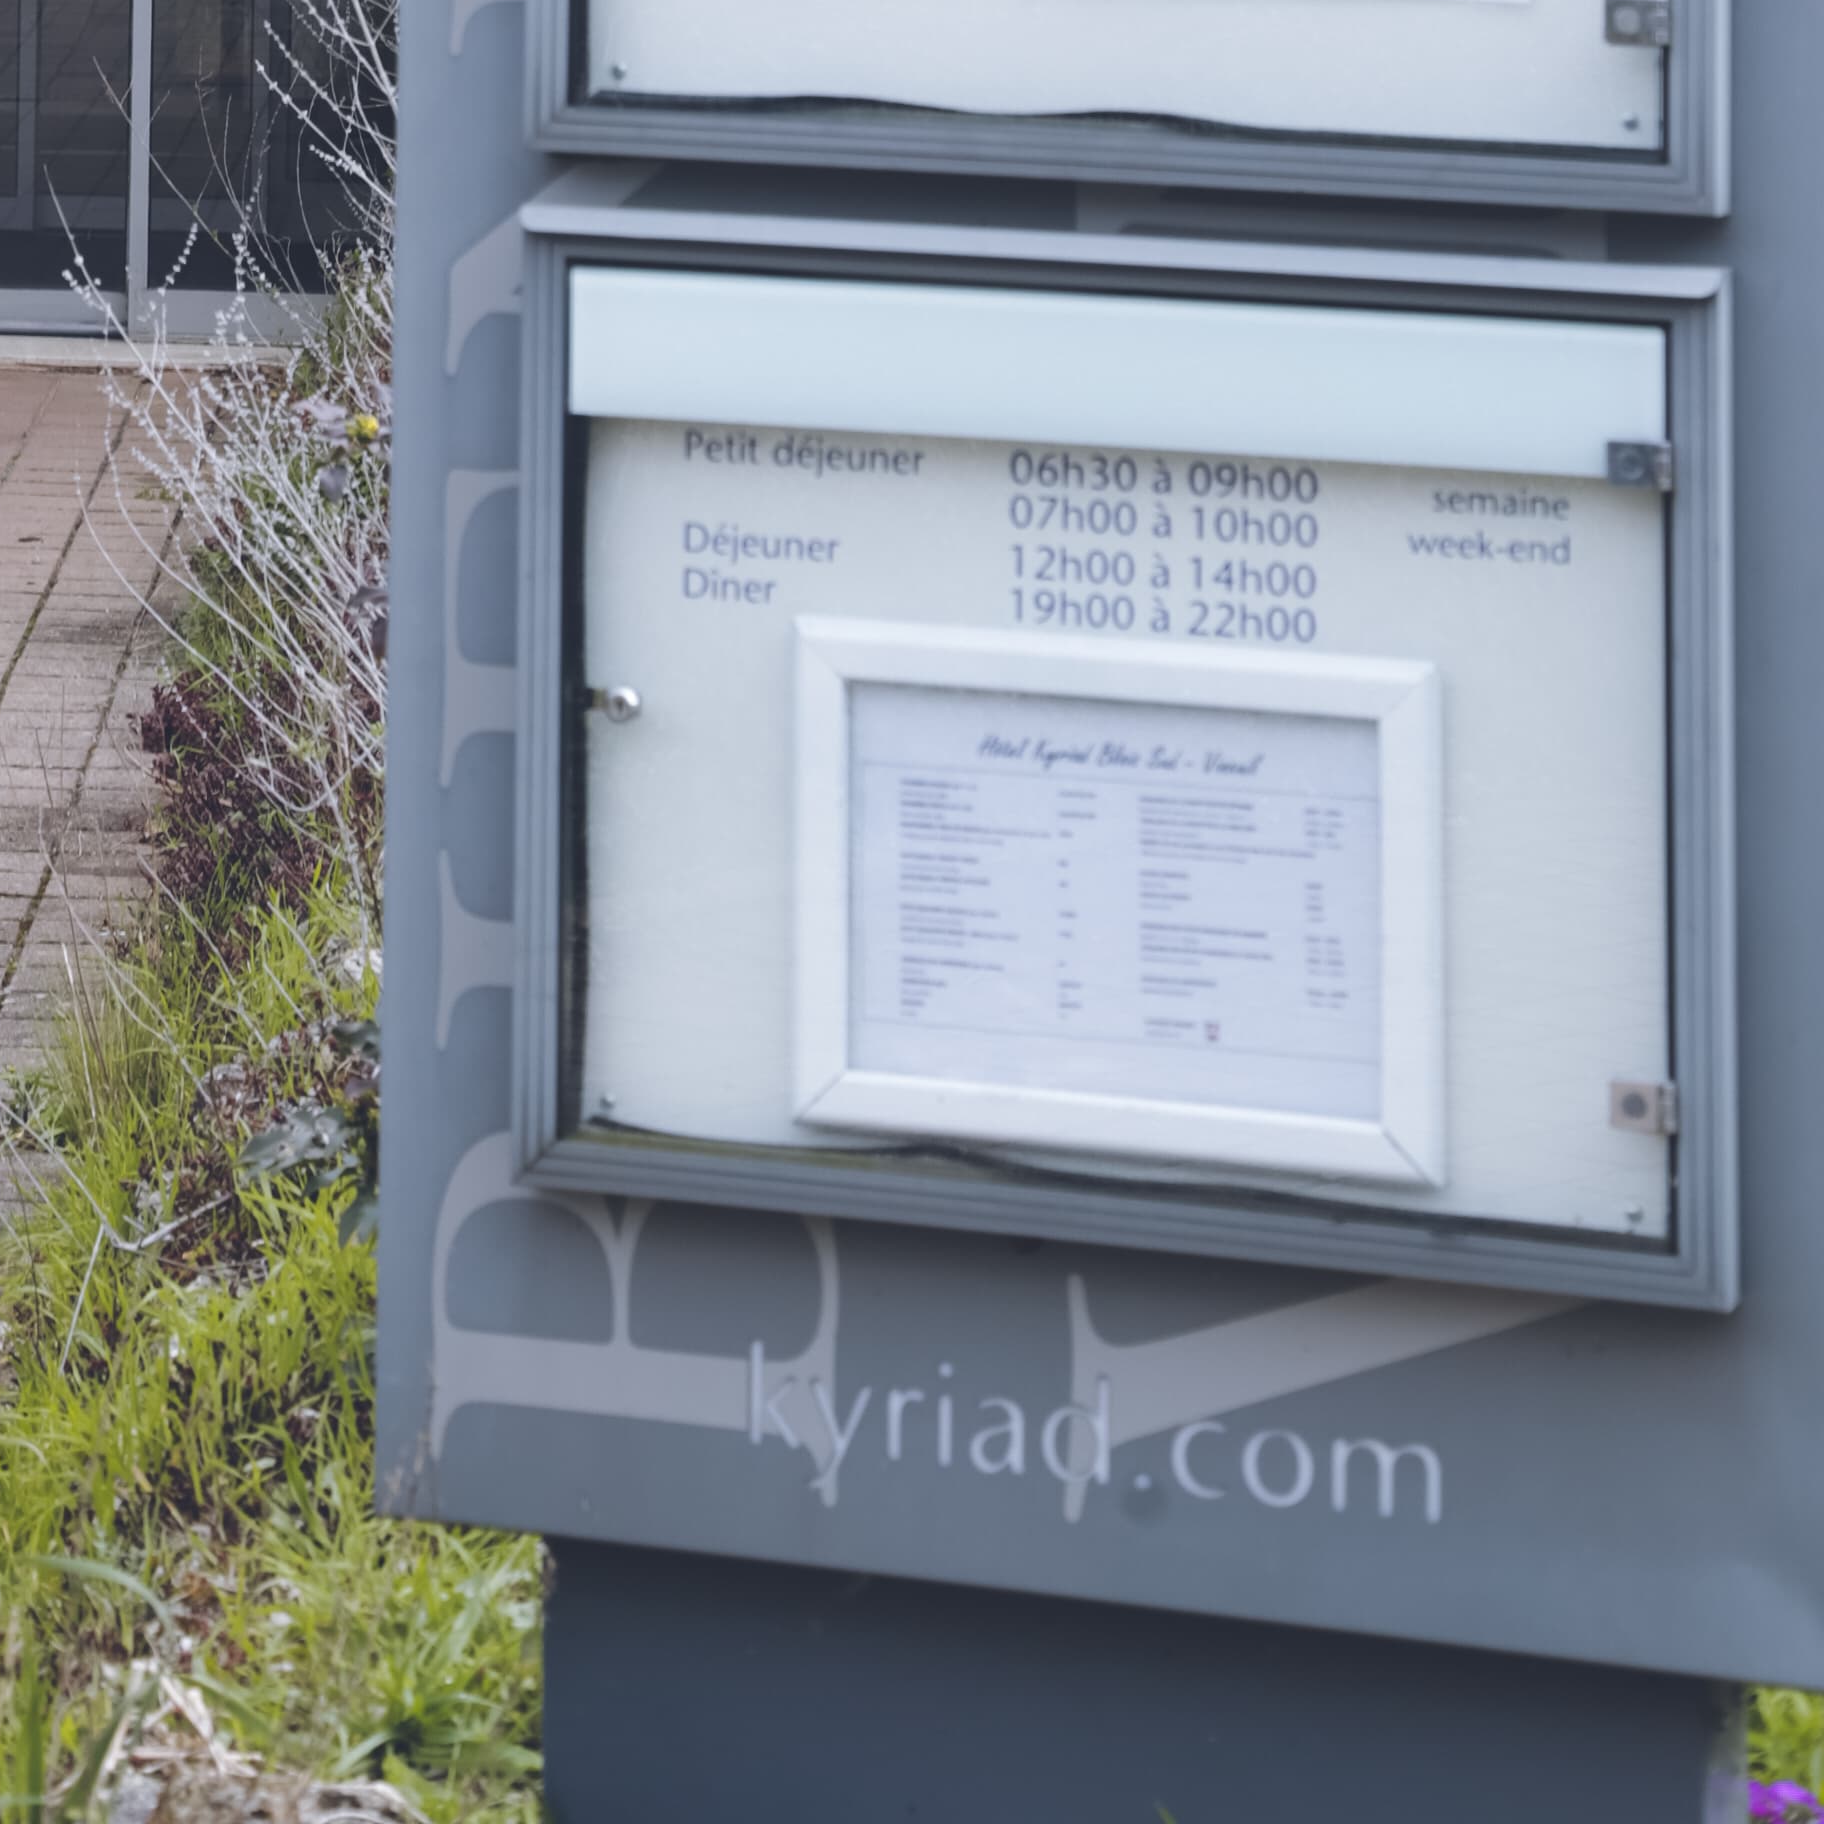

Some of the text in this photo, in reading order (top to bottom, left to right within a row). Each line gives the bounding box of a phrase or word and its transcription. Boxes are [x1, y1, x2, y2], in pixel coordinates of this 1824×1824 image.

[683, 427, 926, 479] Petit déjeuner
[1009, 449, 1320, 504] 06h30 à 09h00
[1009, 494, 1320, 549] 07h00 à 10h00
[1433, 487, 1570, 521] semaine
[683, 519, 841, 566] Déjeuner
[1407, 529, 1572, 566] week-end
[683, 566, 777, 605] Diner
[1011, 545, 1318, 600] 12h00 à 14h00
[1011, 588, 1318, 644] 19h00 à 22h00
[749, 1340, 1443, 1525] kyriad.com
